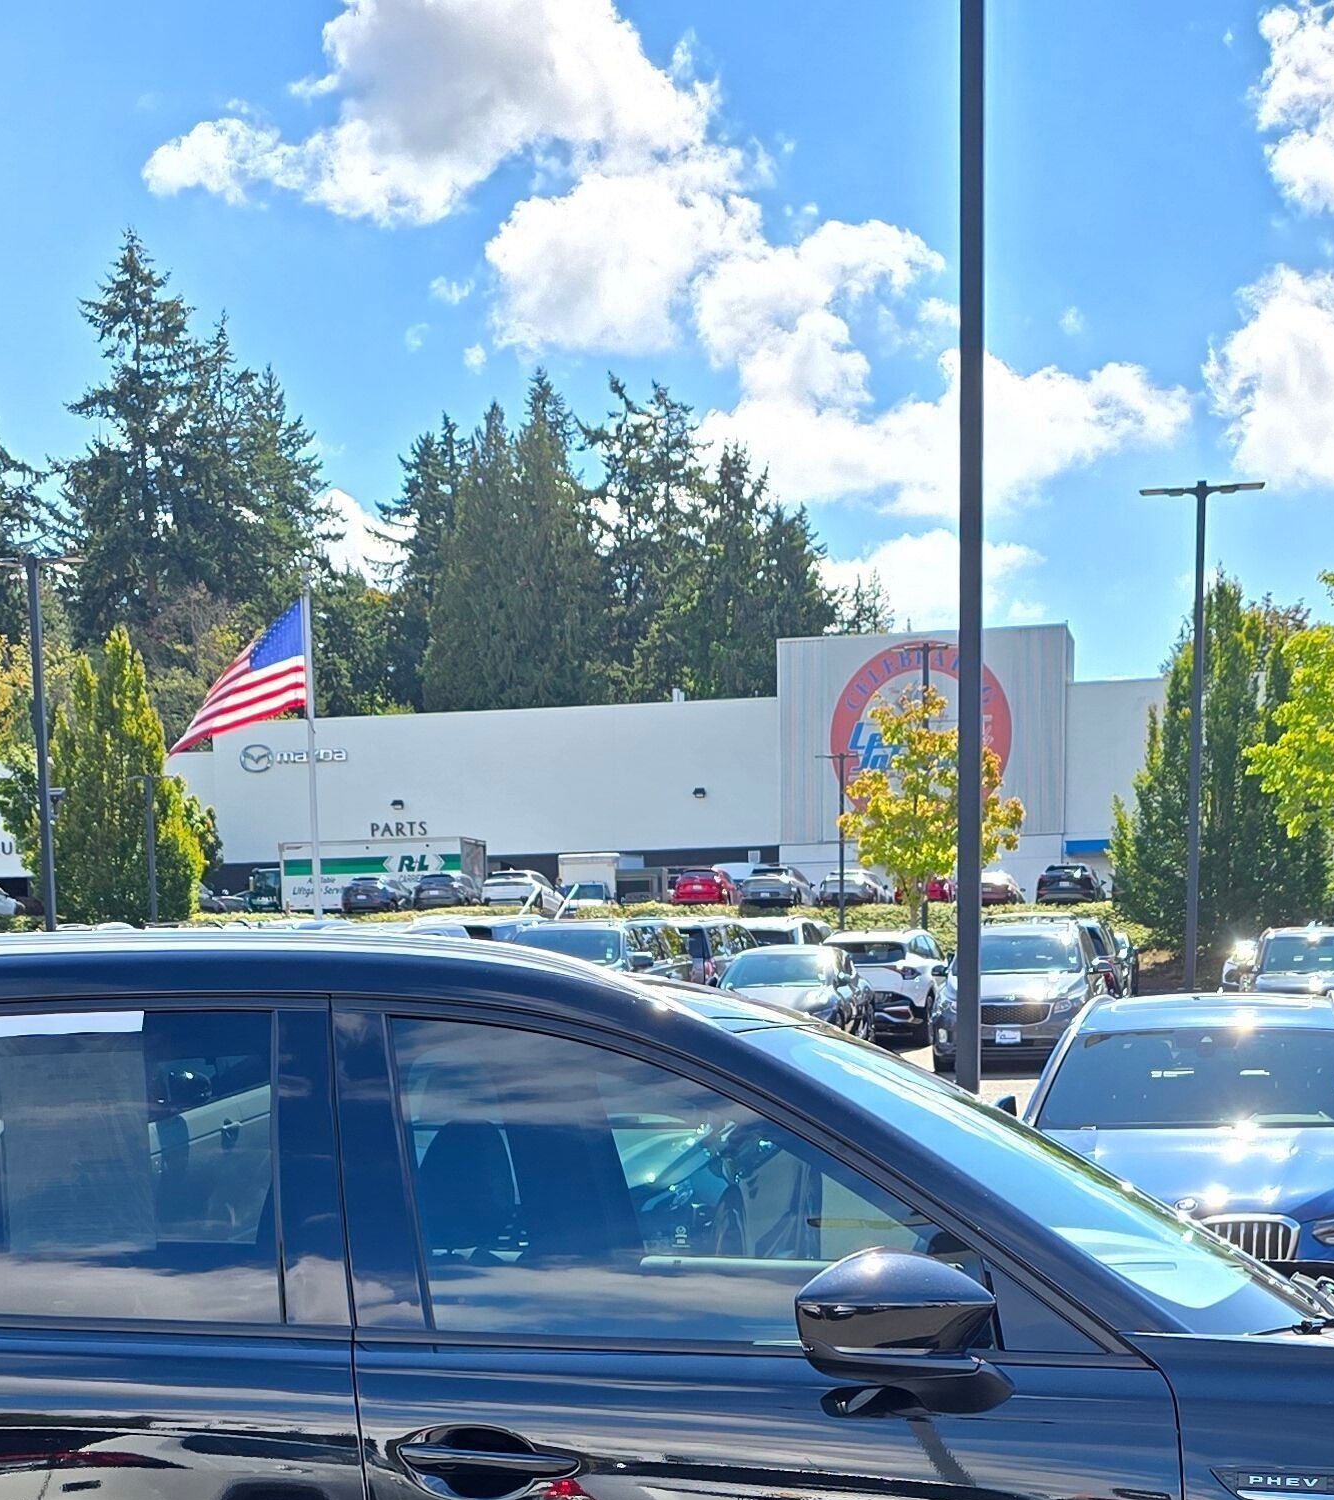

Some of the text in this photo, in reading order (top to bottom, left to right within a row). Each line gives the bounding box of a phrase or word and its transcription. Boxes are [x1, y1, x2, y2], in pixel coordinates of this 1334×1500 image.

[276, 749, 348, 763] mada
[370, 821, 428, 837] PARTS
[1249, 1475, 1319, 1487] PHEV
